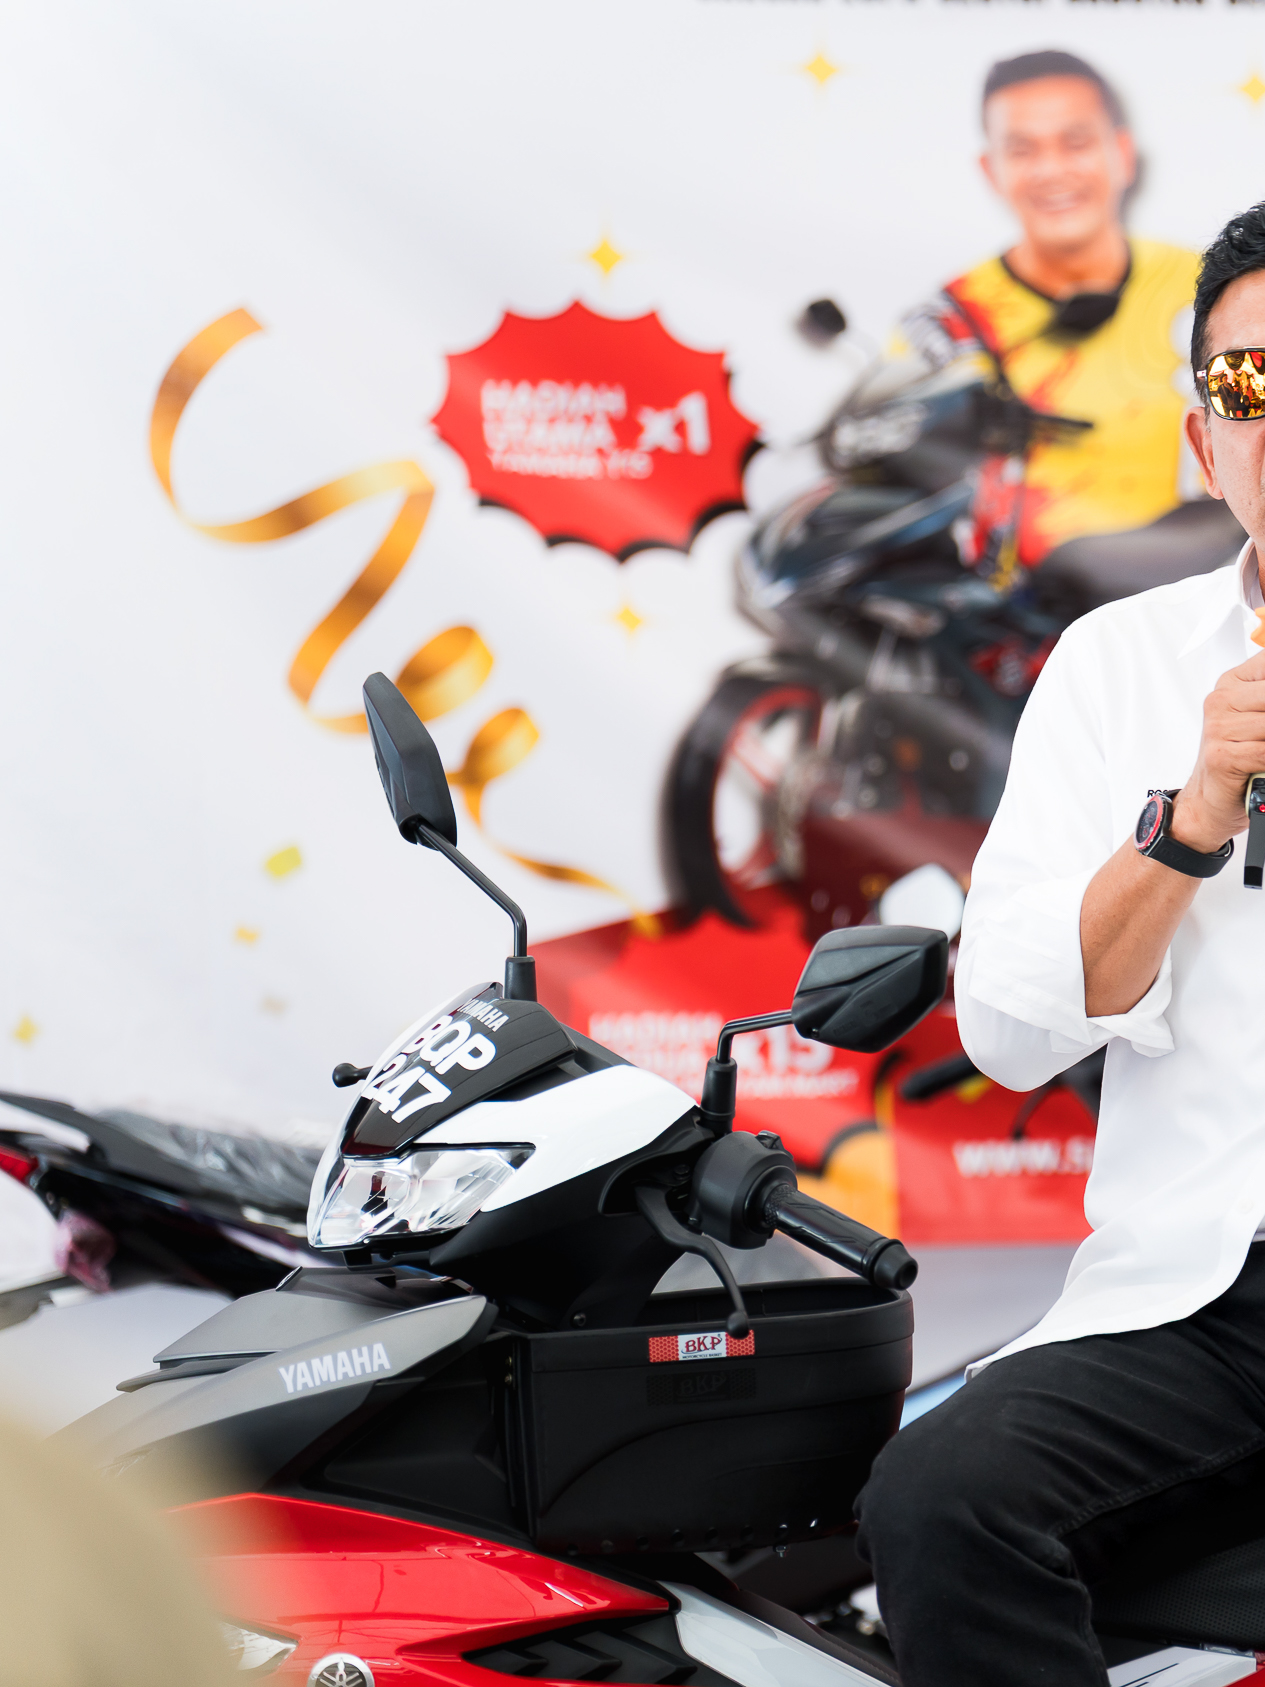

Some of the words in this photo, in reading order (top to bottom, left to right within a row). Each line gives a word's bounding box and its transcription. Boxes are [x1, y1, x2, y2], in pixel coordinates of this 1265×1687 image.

[456, 999, 510, 1033] YAMAHA
[685, 1335, 722, 1353] BKP
[277, 1342, 392, 1394] YAMAHA
